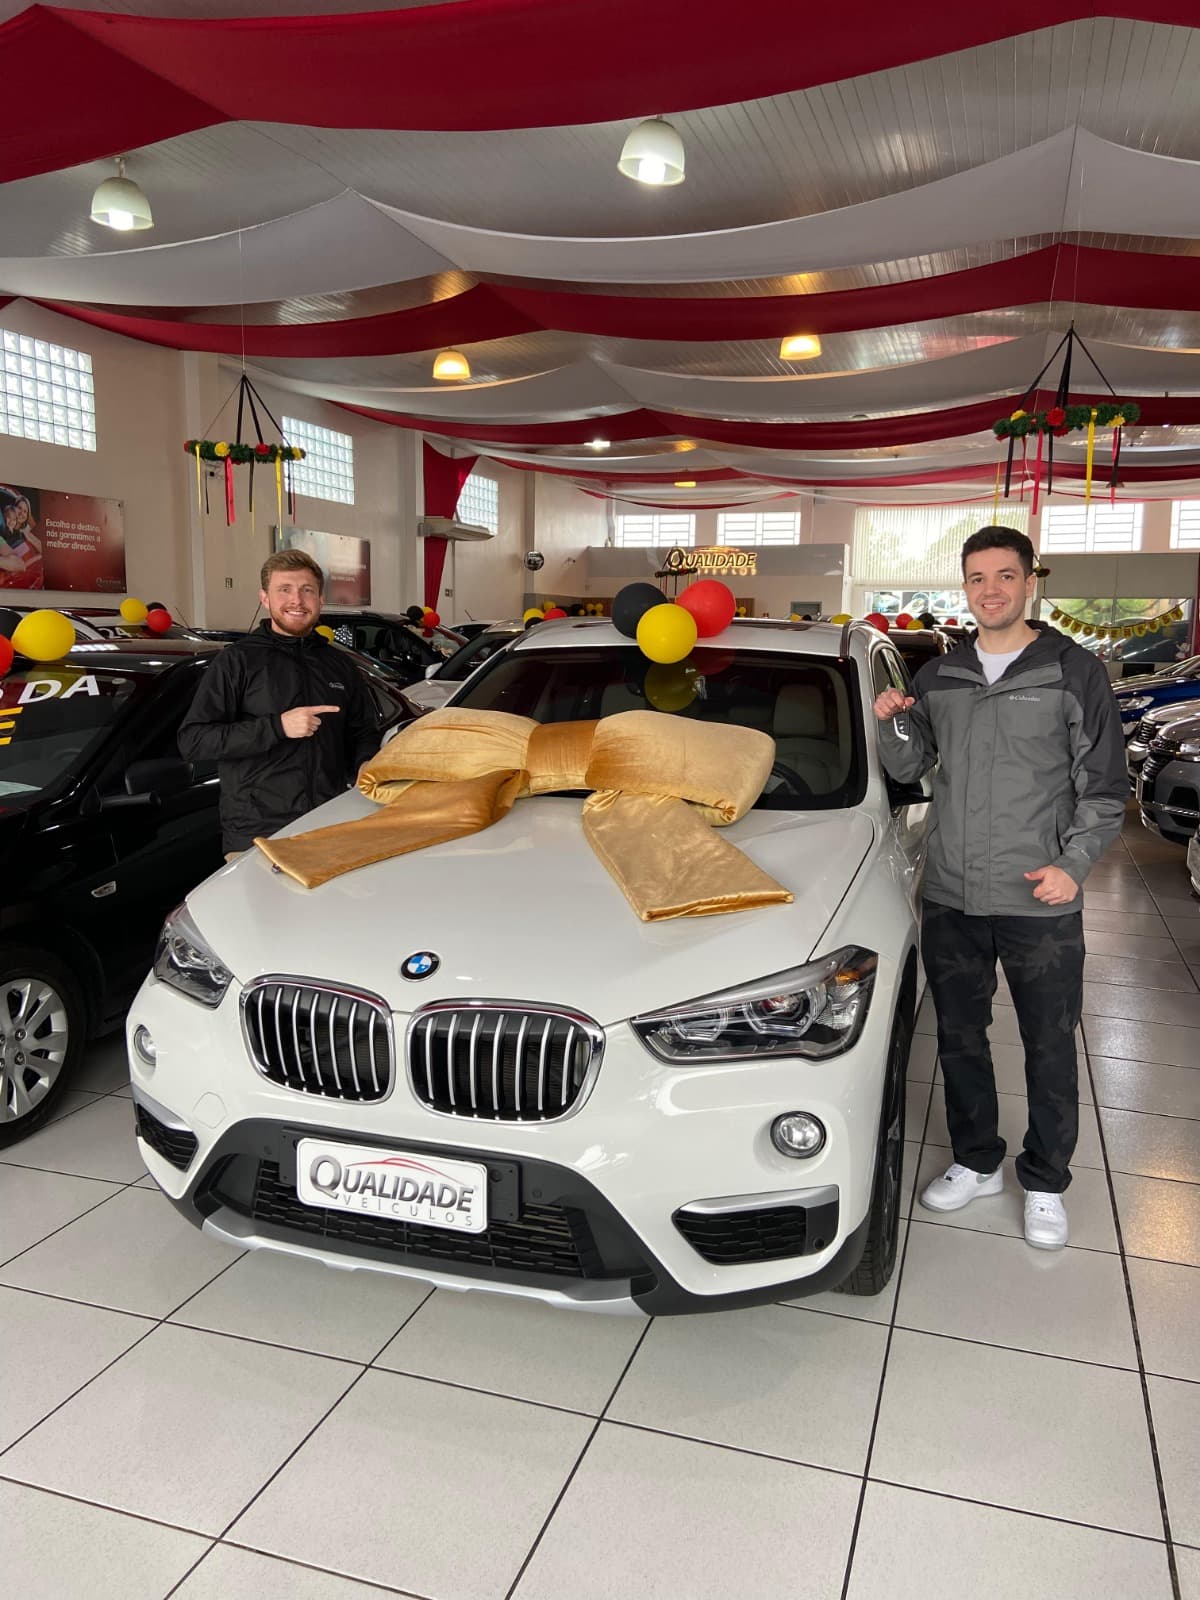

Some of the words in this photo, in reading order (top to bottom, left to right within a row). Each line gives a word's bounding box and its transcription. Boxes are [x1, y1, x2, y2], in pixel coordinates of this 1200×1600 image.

[45, 518, 70, 529] Escolha
[46, 528, 58, 538] nós
[59, 530, 96, 542] garantimos
[46, 540, 70, 550] melhor
[666, 547, 758, 571] QUALIDADE
[309, 1154, 474, 1213] QUALIDADE
